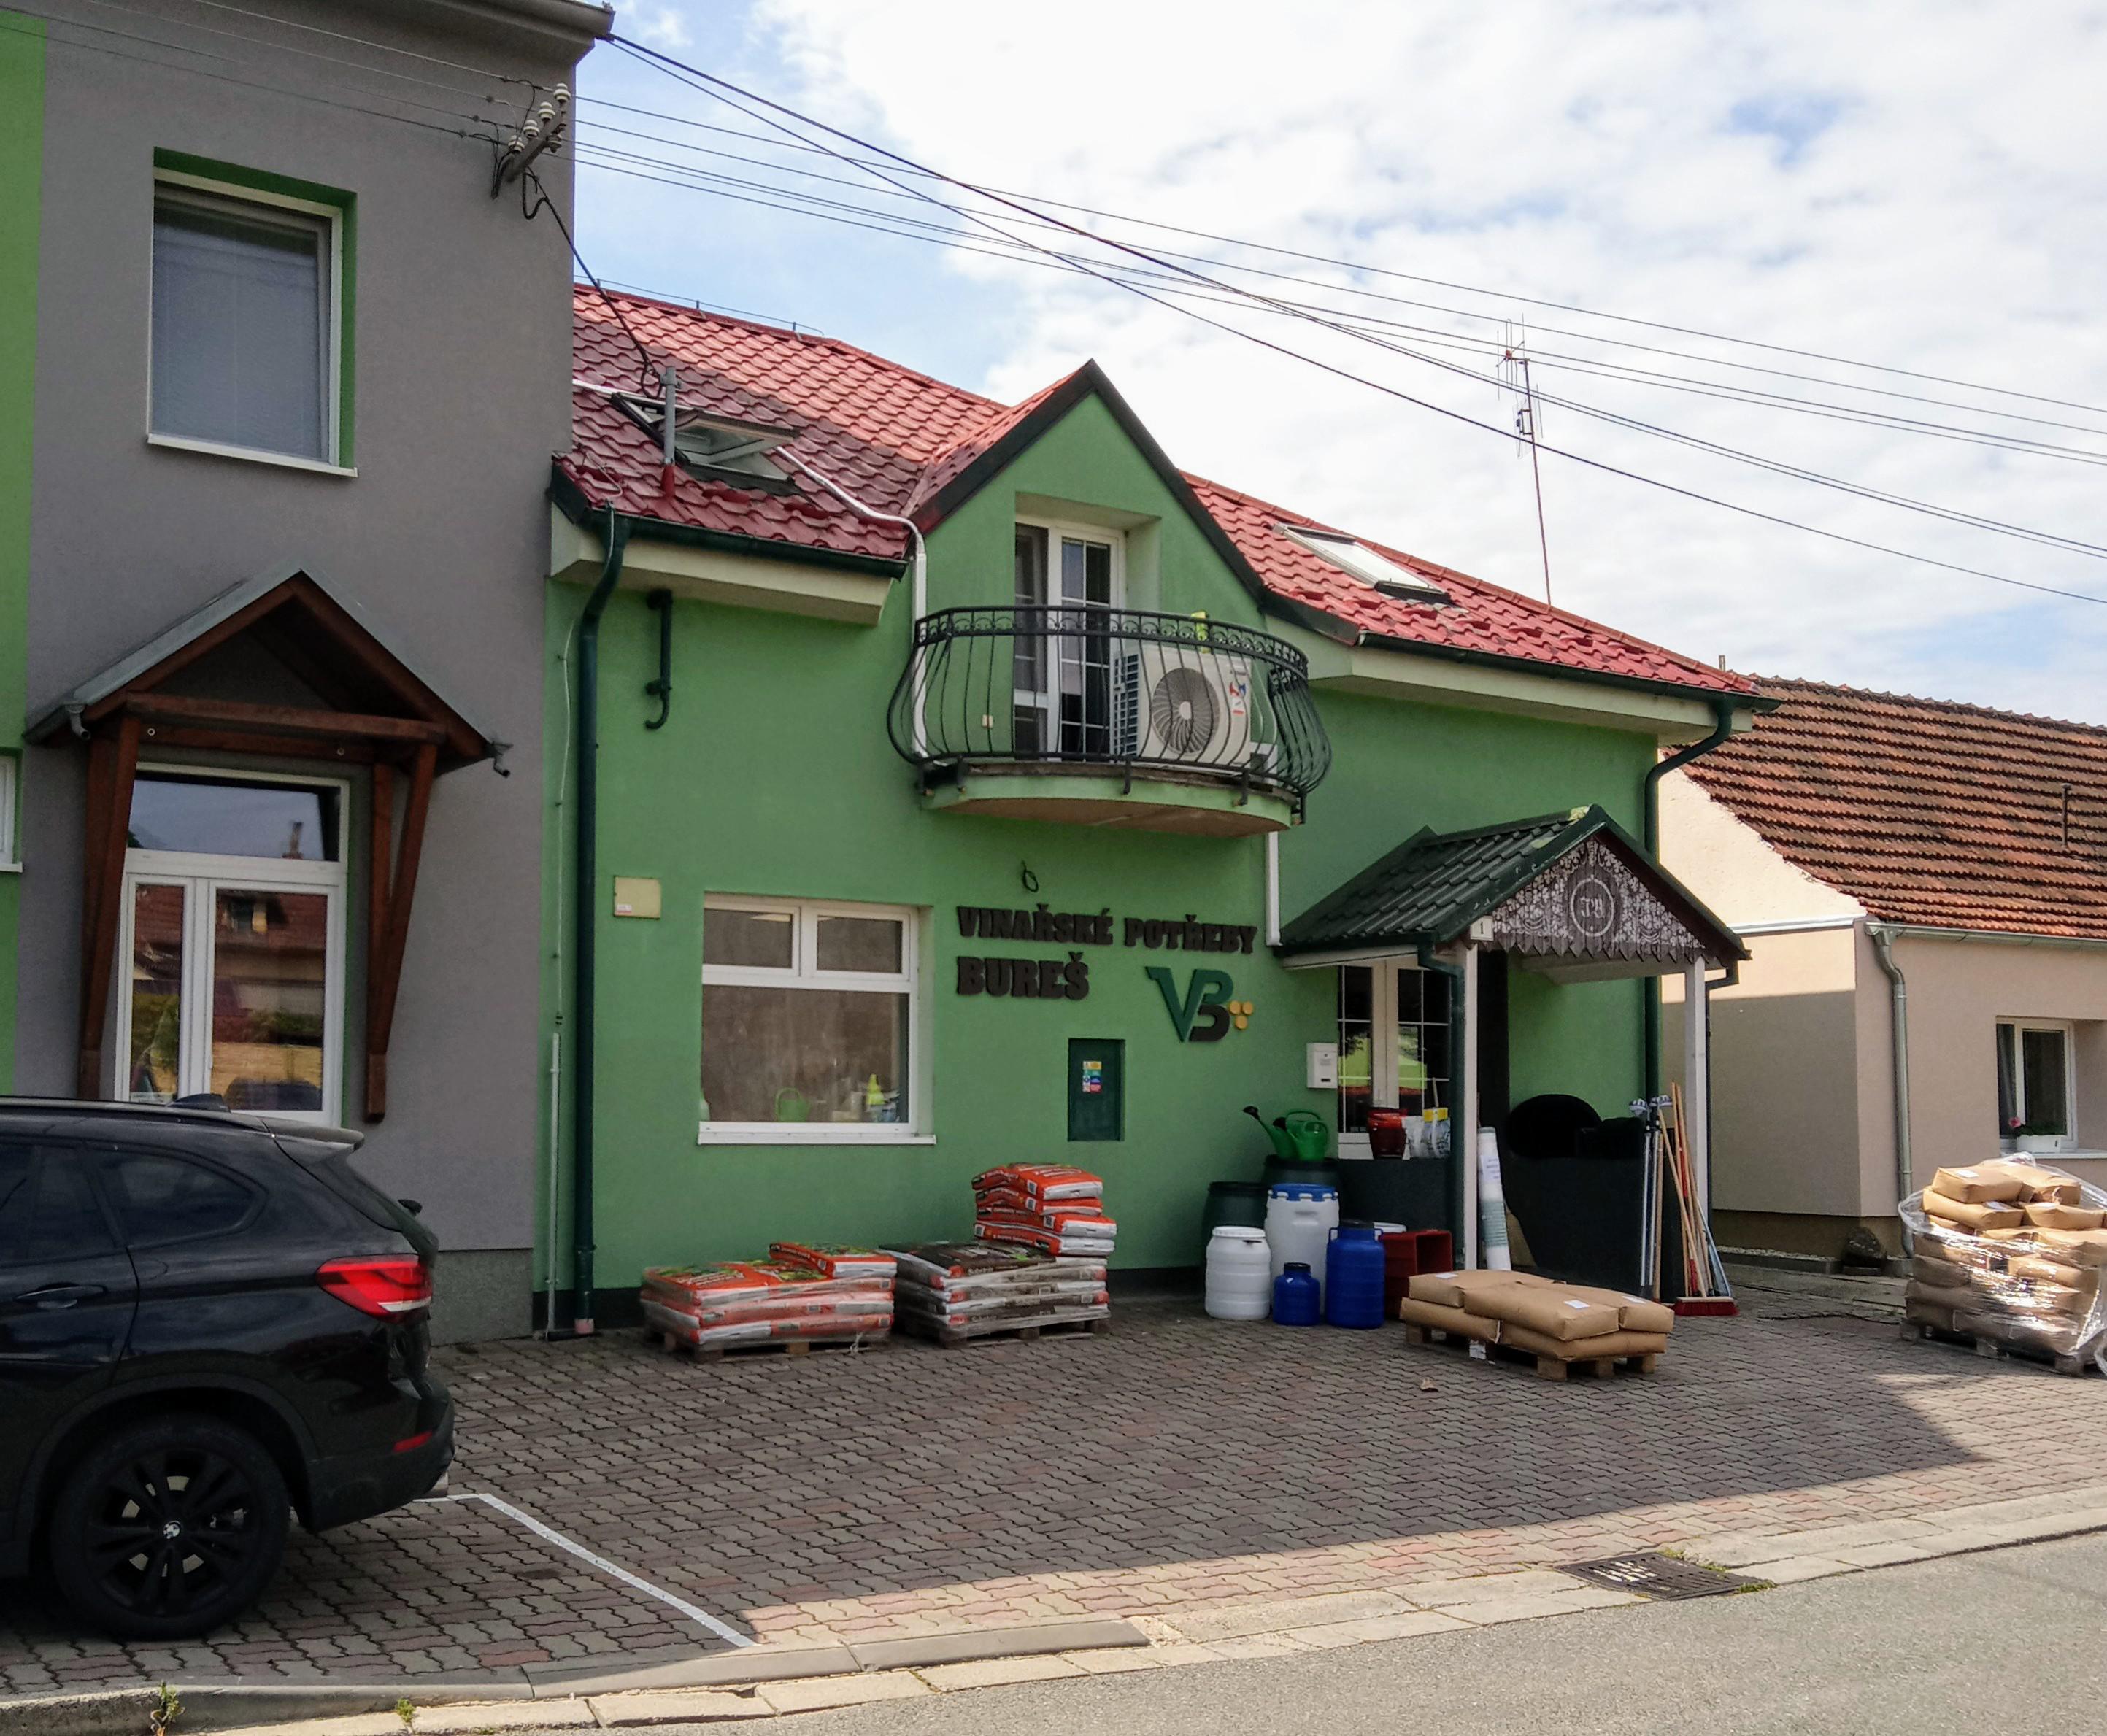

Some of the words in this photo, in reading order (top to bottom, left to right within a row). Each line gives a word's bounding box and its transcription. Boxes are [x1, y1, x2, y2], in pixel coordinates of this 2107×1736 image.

[957, 903, 1114, 946] VINAŘSKÉ
[1124, 914, 1257, 954] POTŘEBY
[957, 951, 1090, 1000] BUREŠ
[1144, 965, 1233, 1043] VB
